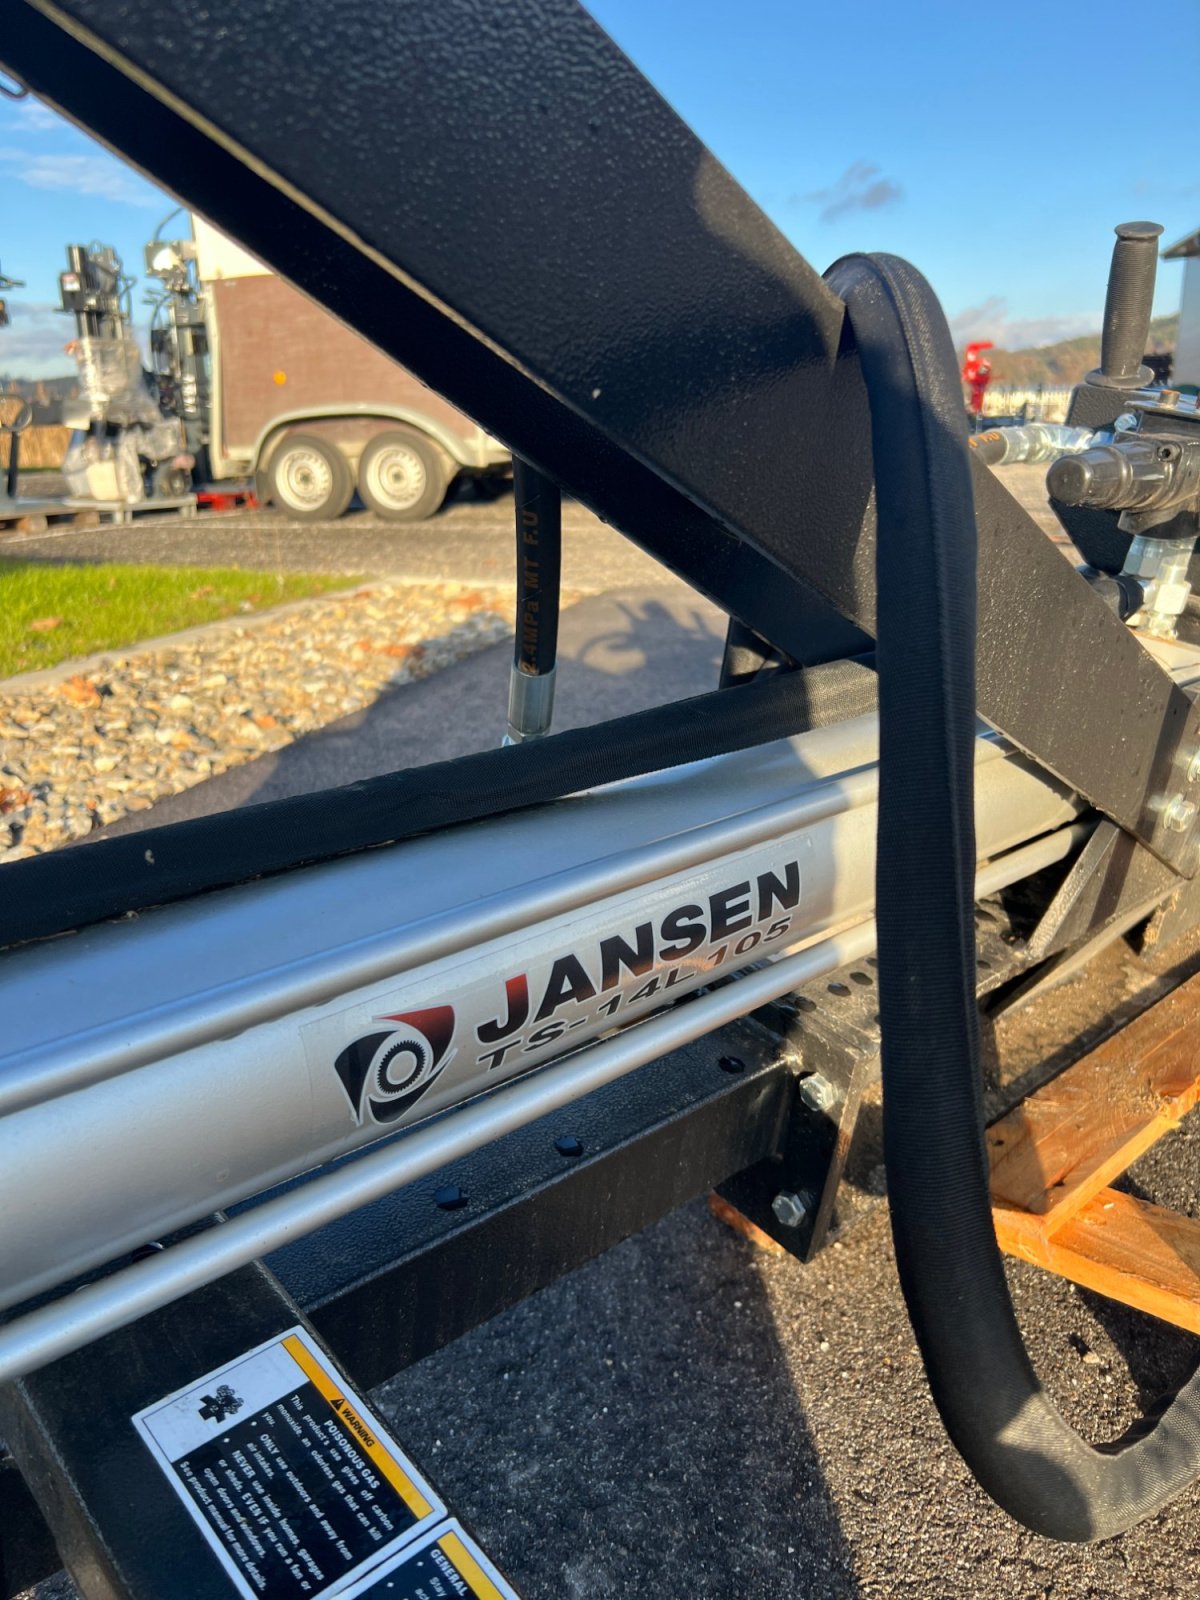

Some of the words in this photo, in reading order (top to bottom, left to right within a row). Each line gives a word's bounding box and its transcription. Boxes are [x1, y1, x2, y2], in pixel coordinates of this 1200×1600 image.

[524, 557, 540, 589] MT
[475, 861, 800, 1043] JANSEN
[341, 1407, 375, 1447] WARNING
[218, 1459, 228, 1467] or
[246, 1442, 257, 1452] air
[290, 1394, 304, 1410] This
[329, 1447, 342, 1461] use
[340, 1465, 360, 1485] gives
[360, 1489, 375, 1501] off
[371, 1504, 394, 1531] carbon
[323, 1419, 365, 1470] POISONOUS
[360, 1468, 380, 1489] GAS
[203, 1467, 220, 1486] open
[216, 1487, 235, 1509] doors
[229, 1507, 246, 1525] and
[241, 1492, 263, 1517] EVEN
[259, 1433, 280, 1454] ONLY
[275, 1456, 288, 1470] use
[285, 1470, 312, 1503] outdoors
[308, 1503, 325, 1519] and
[319, 1519, 338, 1540] away
[335, 1539, 353, 1560] from
[301, 1437, 311, 1447] an
[310, 1449, 335, 1479] odorless
[331, 1480, 346, 1494] gas
[343, 1494, 360, 1511] that
[356, 1512, 370, 1527] can
[367, 1526, 383, 1541] kill
[179, 1460, 193, 1480] See
[187, 1473, 213, 1505] product
[207, 1504, 231, 1531] manual
[224, 1529, 237, 1545] for
[232, 1540, 249, 1562] more
[231, 1449, 256, 1478] NEVER
[251, 1480, 265, 1494] use
[261, 1493, 281, 1518] inside
[296, 1548, 324, 1580] garages
[256, 1515, 270, 1525] IF
[262, 1526, 278, 1542] you
[274, 1542, 288, 1557] run
[289, 1563, 303, 1579] fan
[300, 1580, 312, 1590] or
[430, 1549, 468, 1596] GENERAL
[430, 1577, 447, 1597] Stay
